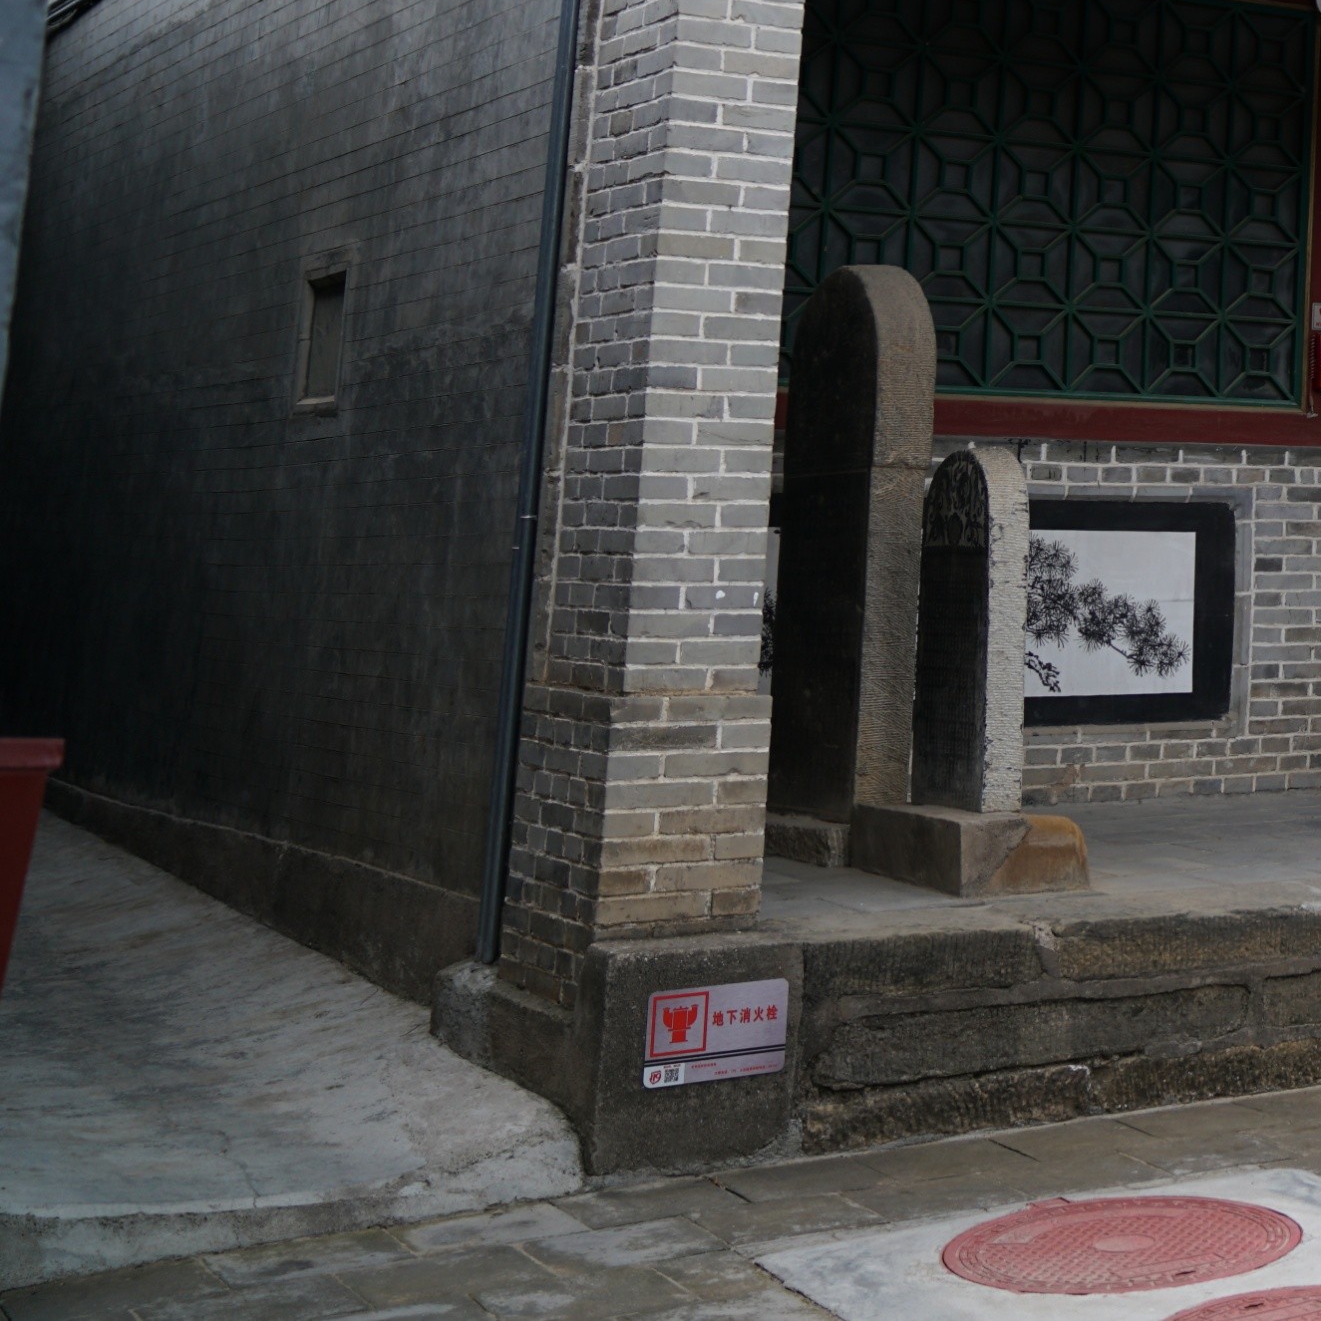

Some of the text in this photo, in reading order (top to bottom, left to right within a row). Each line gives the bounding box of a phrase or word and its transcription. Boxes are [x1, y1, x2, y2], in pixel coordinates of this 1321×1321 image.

[712, 1004, 778, 1027] 地下消火栓
